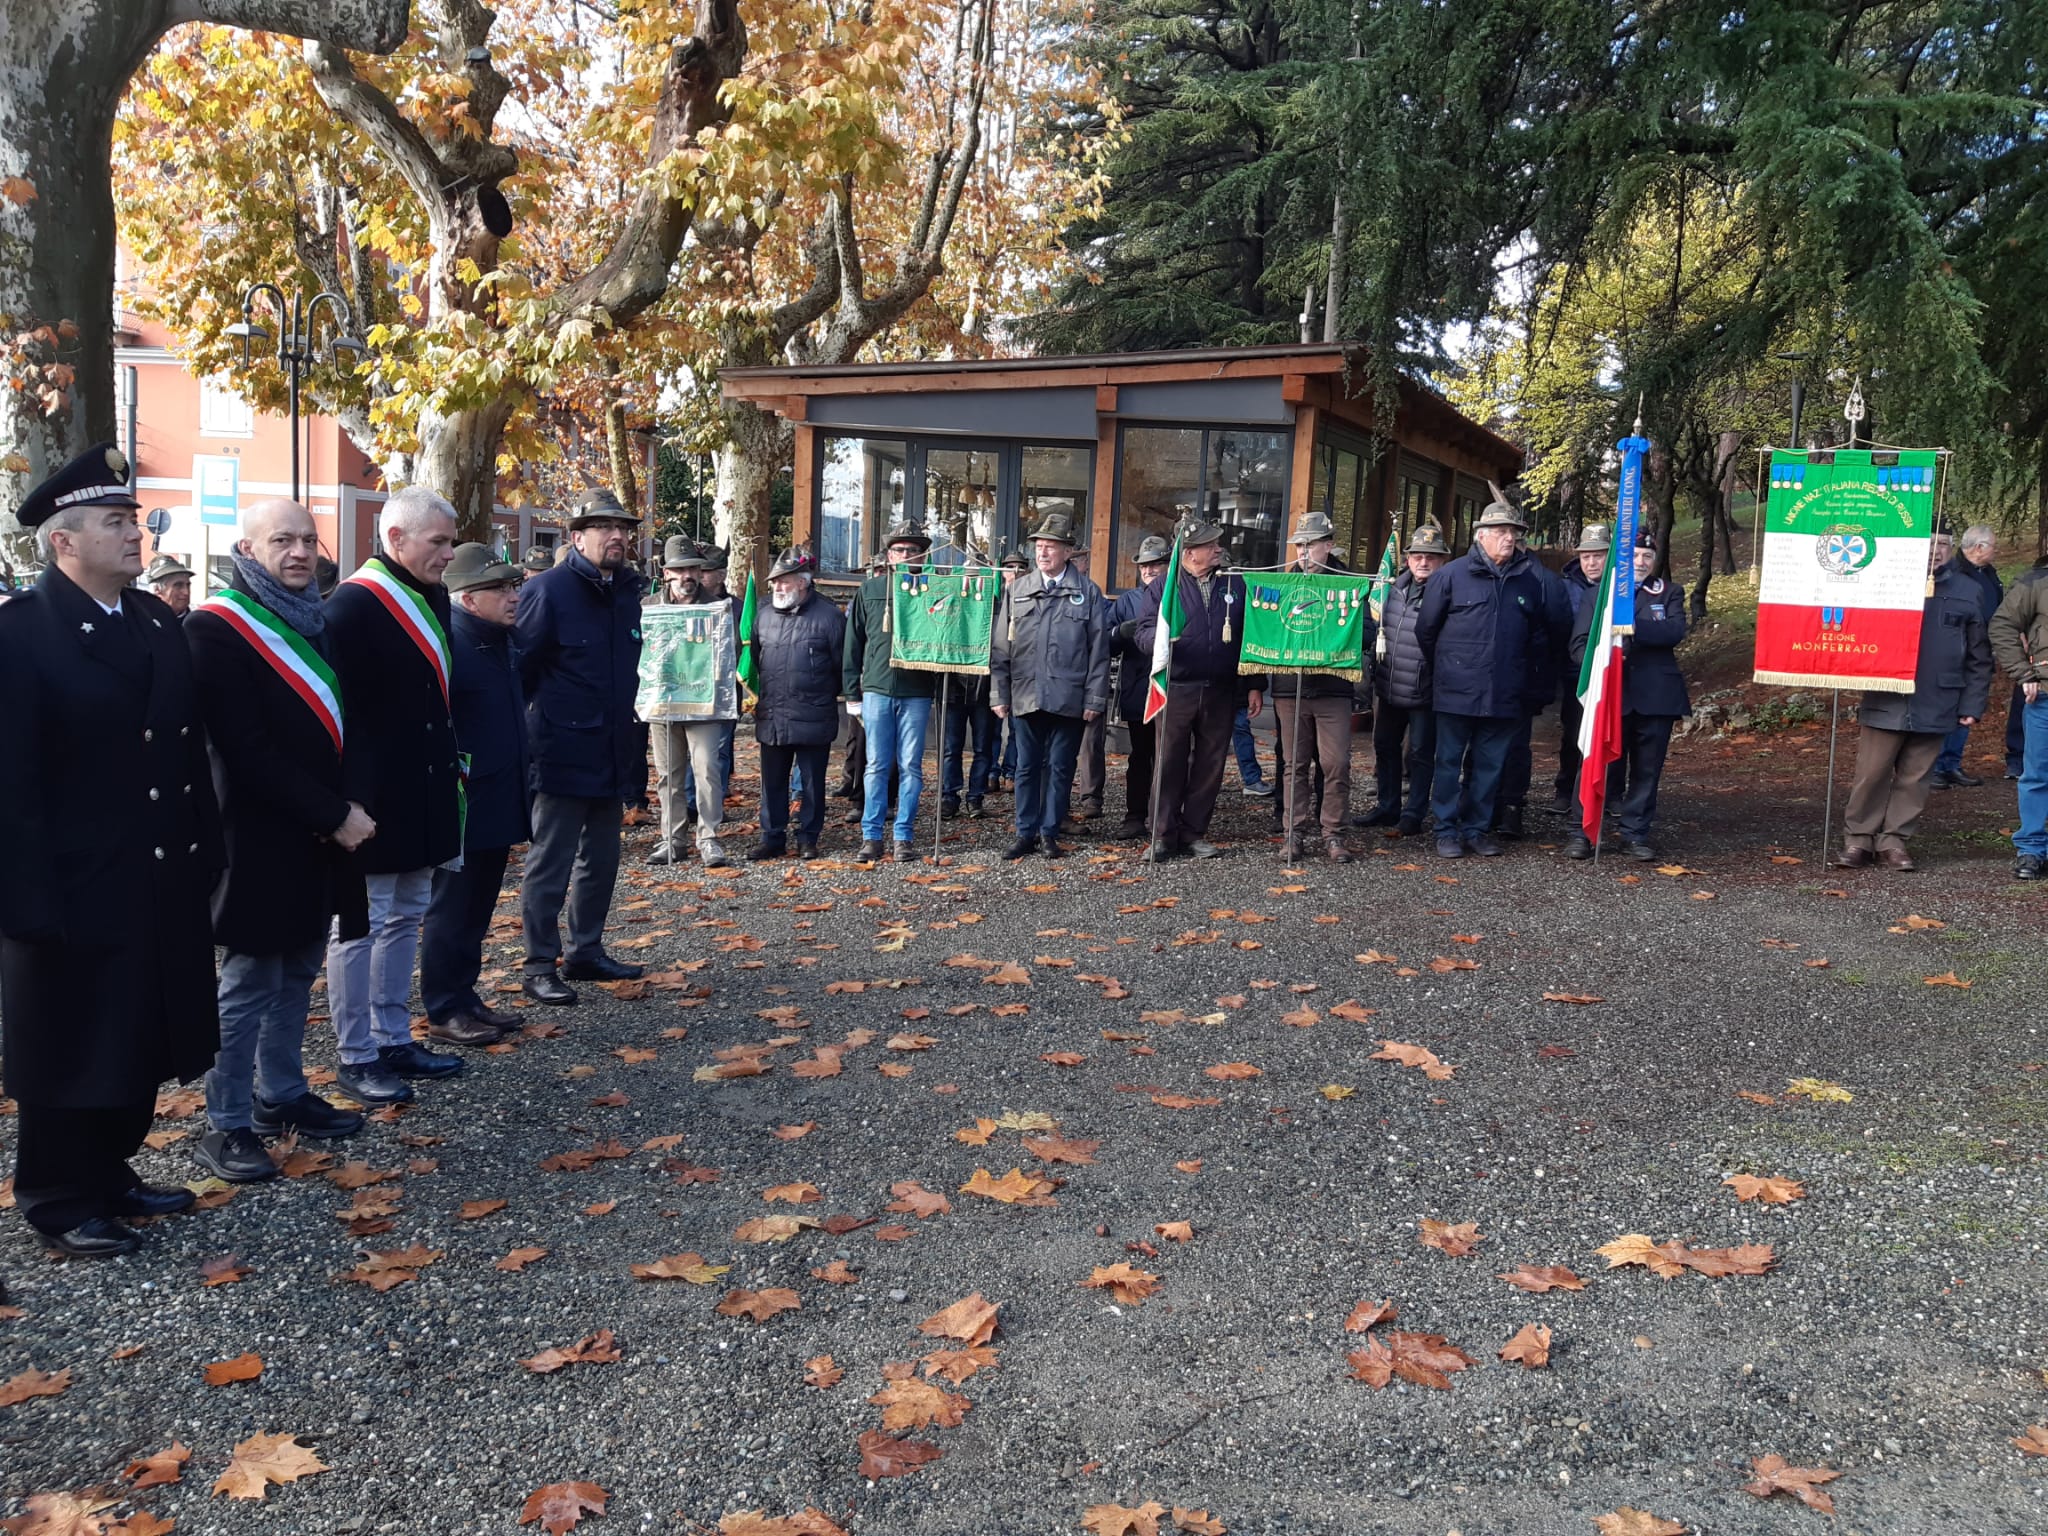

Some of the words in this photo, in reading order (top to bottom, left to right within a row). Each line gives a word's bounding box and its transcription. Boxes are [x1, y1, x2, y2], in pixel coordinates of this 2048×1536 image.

[1623, 465, 1636, 495] CONG.
[1784, 498, 1807, 526] UNIONE
[1894, 502, 1914, 529] RUSSIA
[1620, 497, 1634, 557] CARABINIERI
[1618, 558, 1630, 578] NAZ.
[1617, 580, 1629, 598] ASS.
[1245, 643, 1280, 659] SEZIONE
[1791, 641, 1879, 654] MONFERRATO
